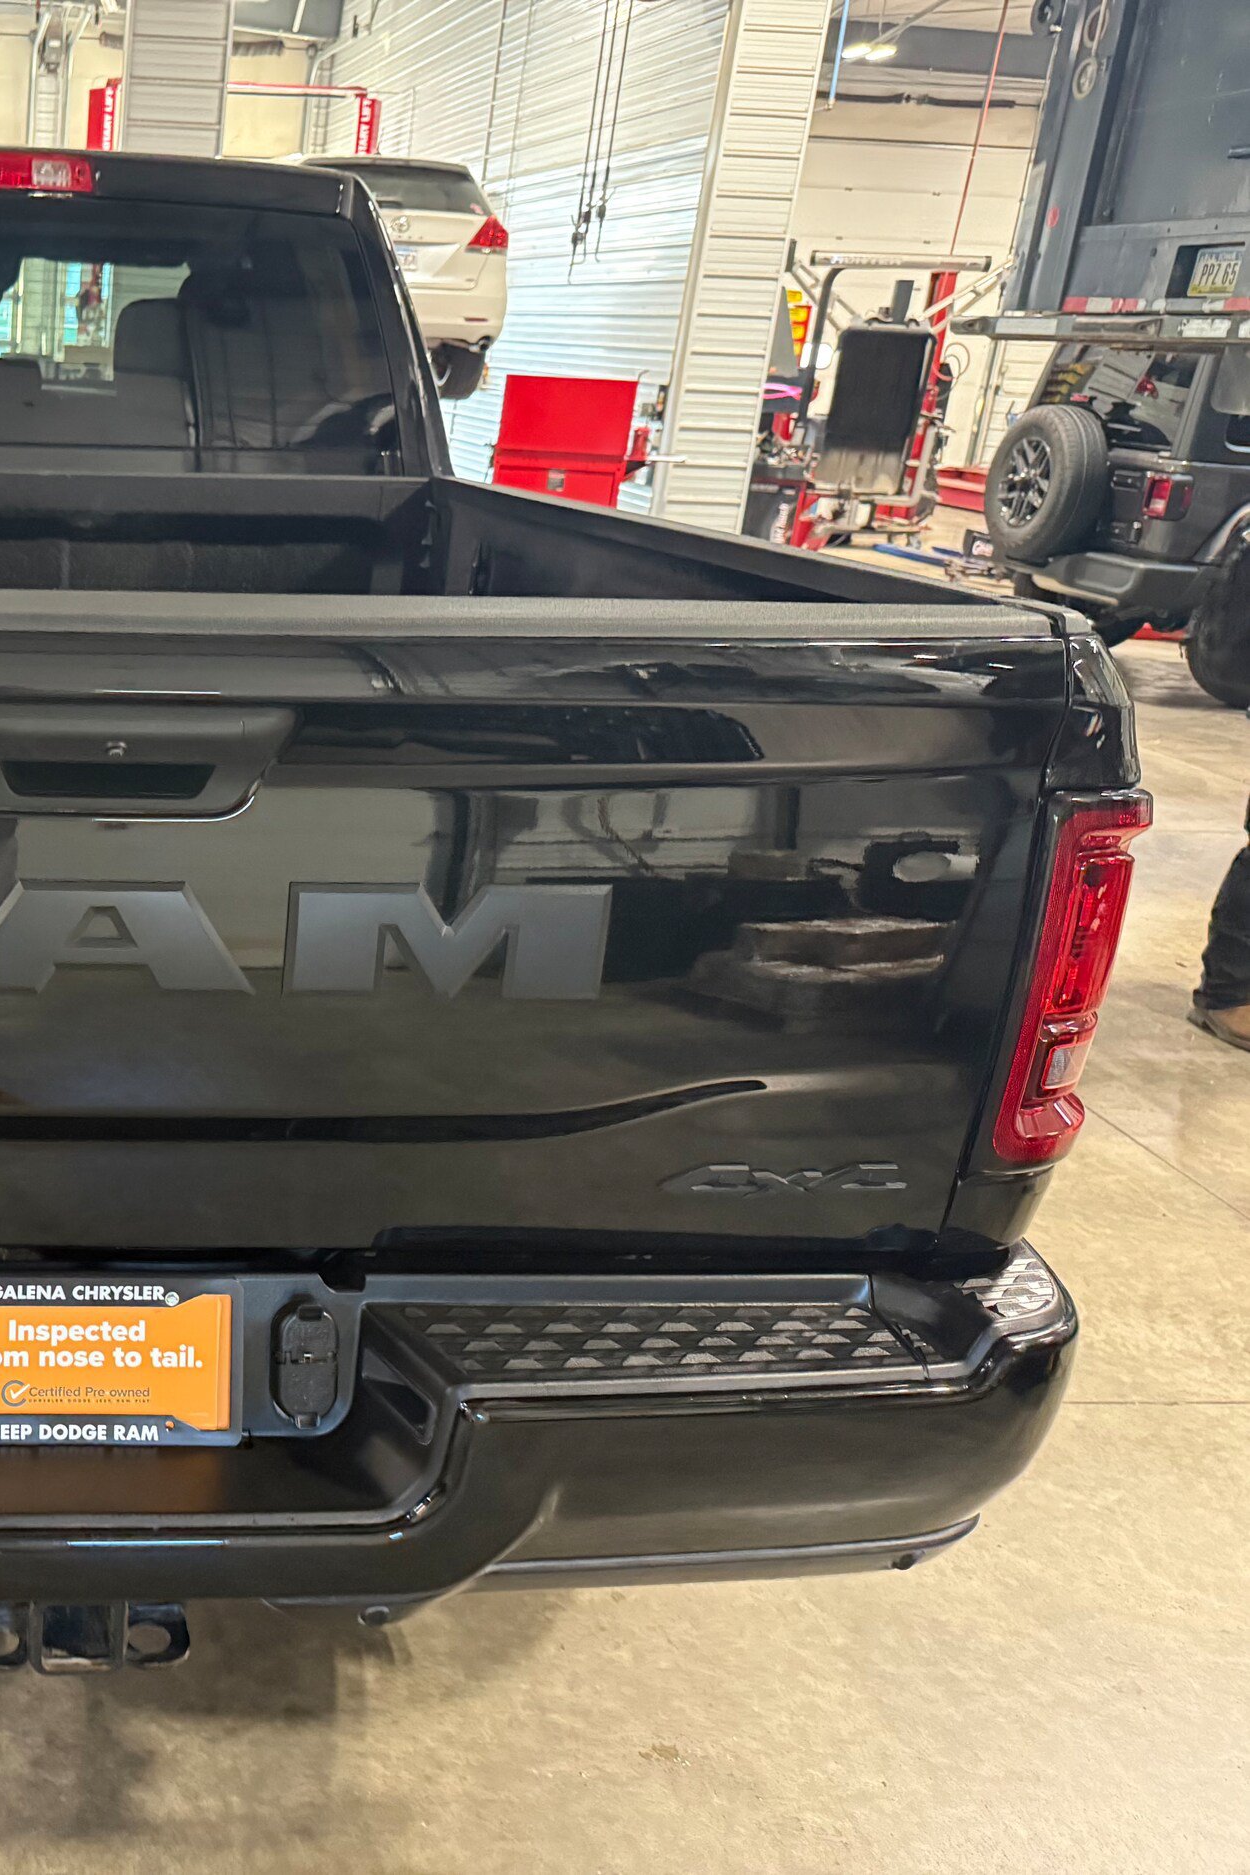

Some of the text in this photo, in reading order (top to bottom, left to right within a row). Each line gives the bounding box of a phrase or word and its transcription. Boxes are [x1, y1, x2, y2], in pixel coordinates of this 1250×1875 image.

[102, 87, 115, 151] OTARY LIFT
[360, 100, 373, 122] LIFT
[1199, 263, 1239, 286] PPZ 65
[72, 1285, 165, 1301] CHRYSLER
[8, 1320, 146, 1346] Inspected
[38, 1349, 105, 1368] nose
[113, 1347, 142, 1368] to
[150, 1345, 203, 1368] tail.
[28, 1386, 81, 1398] Certified
[39, 1424, 107, 1441] DODGE
[113, 1425, 159, 1441] RAM
